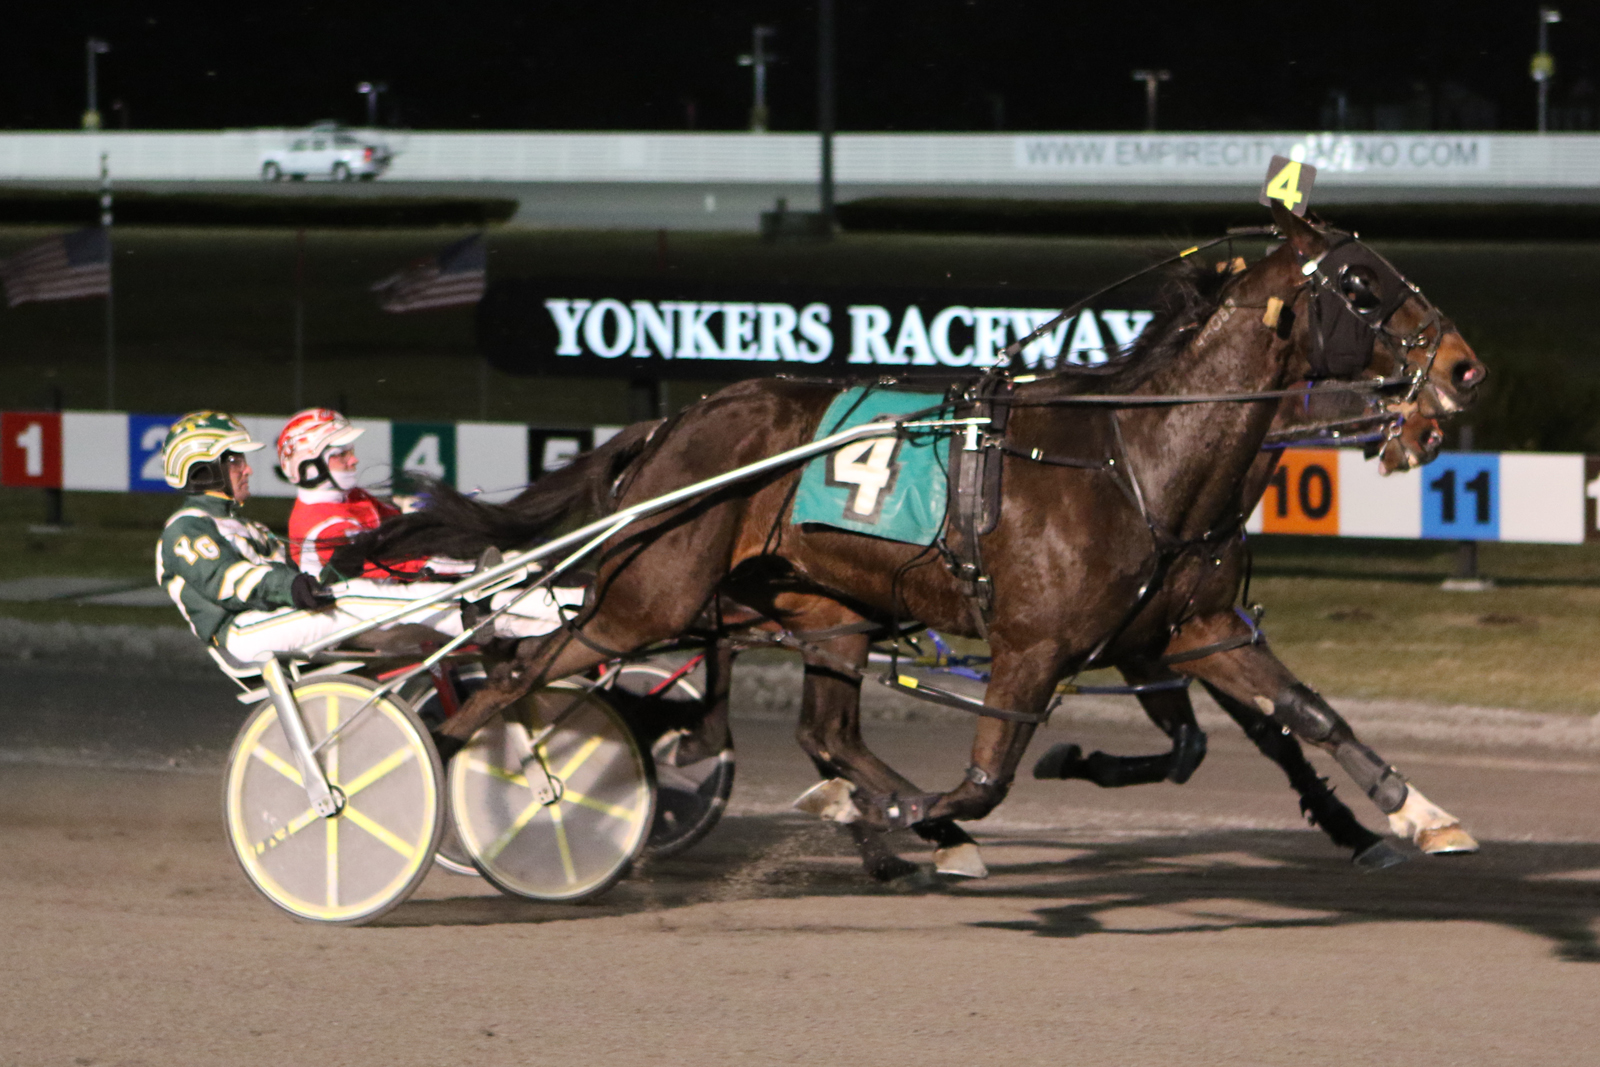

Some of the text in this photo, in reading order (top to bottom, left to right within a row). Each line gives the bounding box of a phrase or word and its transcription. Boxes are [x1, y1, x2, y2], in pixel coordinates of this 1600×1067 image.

[1266, 160, 1303, 211] 4
[546, 299, 1155, 368] YONKERS RACEWAY
[16, 421, 43, 477] 1
[402, 433, 446, 482] 4
[828, 425, 898, 522] 4
[1268, 464, 1333, 520] 10
[1430, 469, 1492, 525] 11
